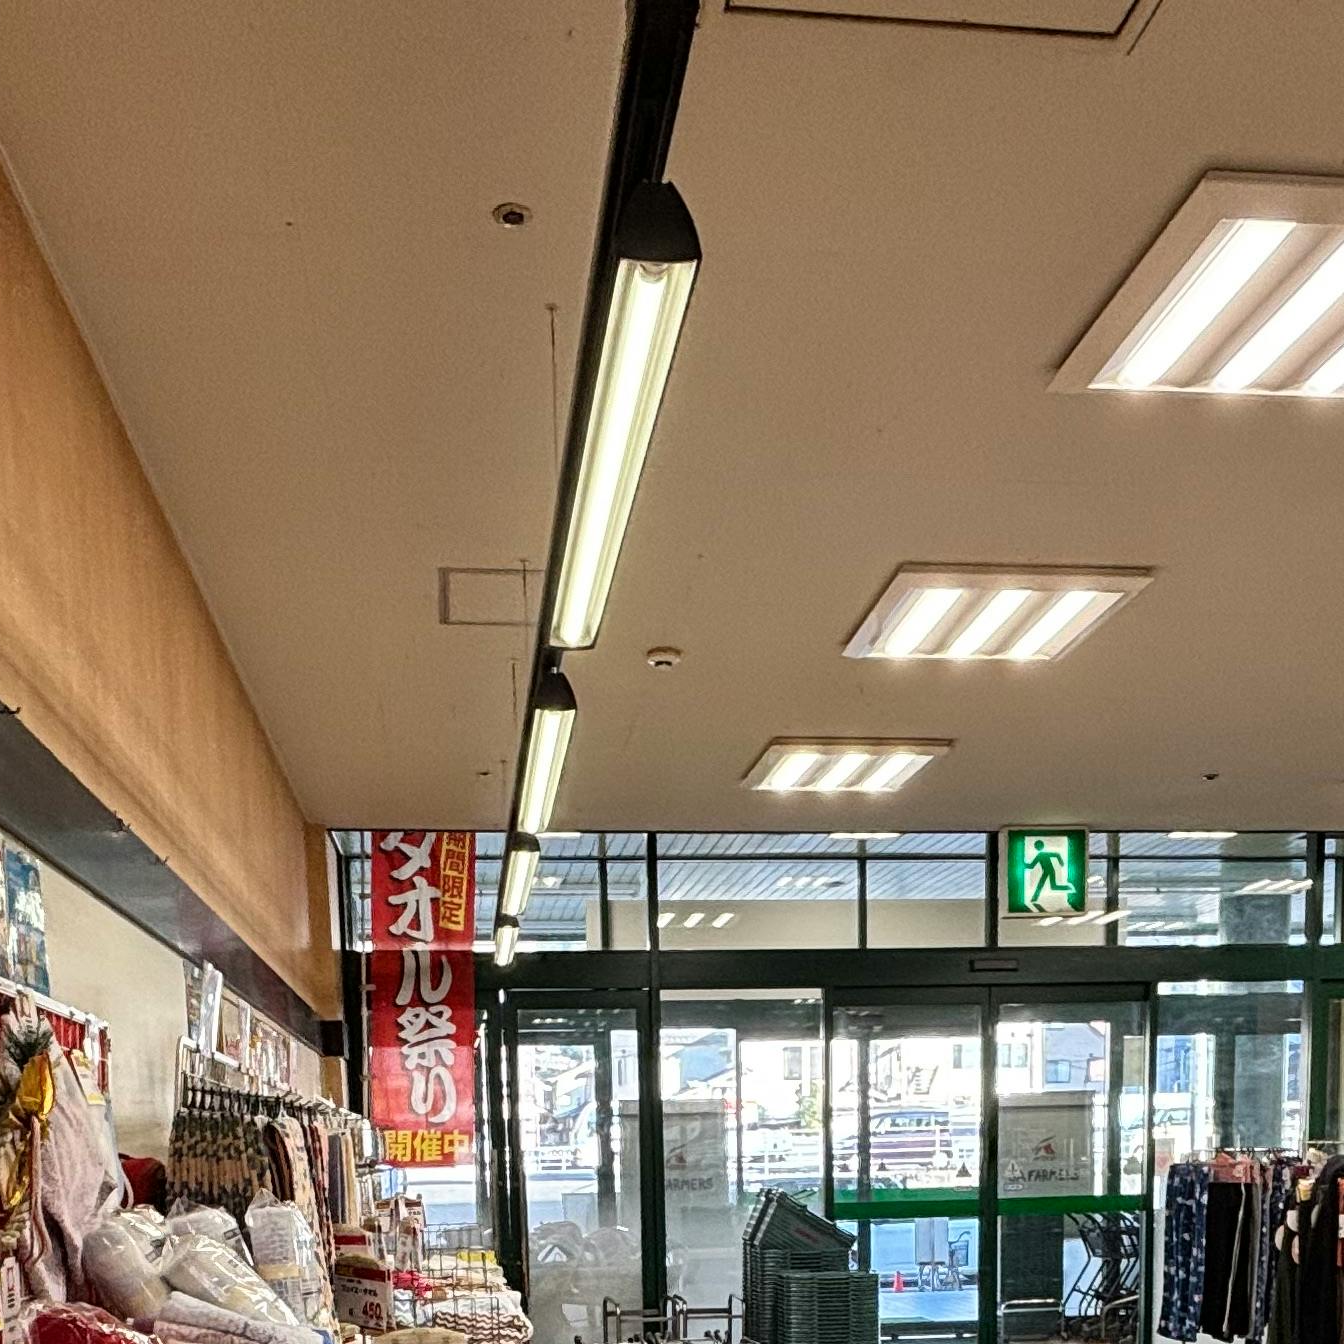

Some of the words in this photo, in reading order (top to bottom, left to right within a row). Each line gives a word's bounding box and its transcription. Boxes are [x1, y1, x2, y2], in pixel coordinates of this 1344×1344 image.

[384, 1130, 471, 1162] 開催中
[666, 1177, 713, 1191] ARMERS
